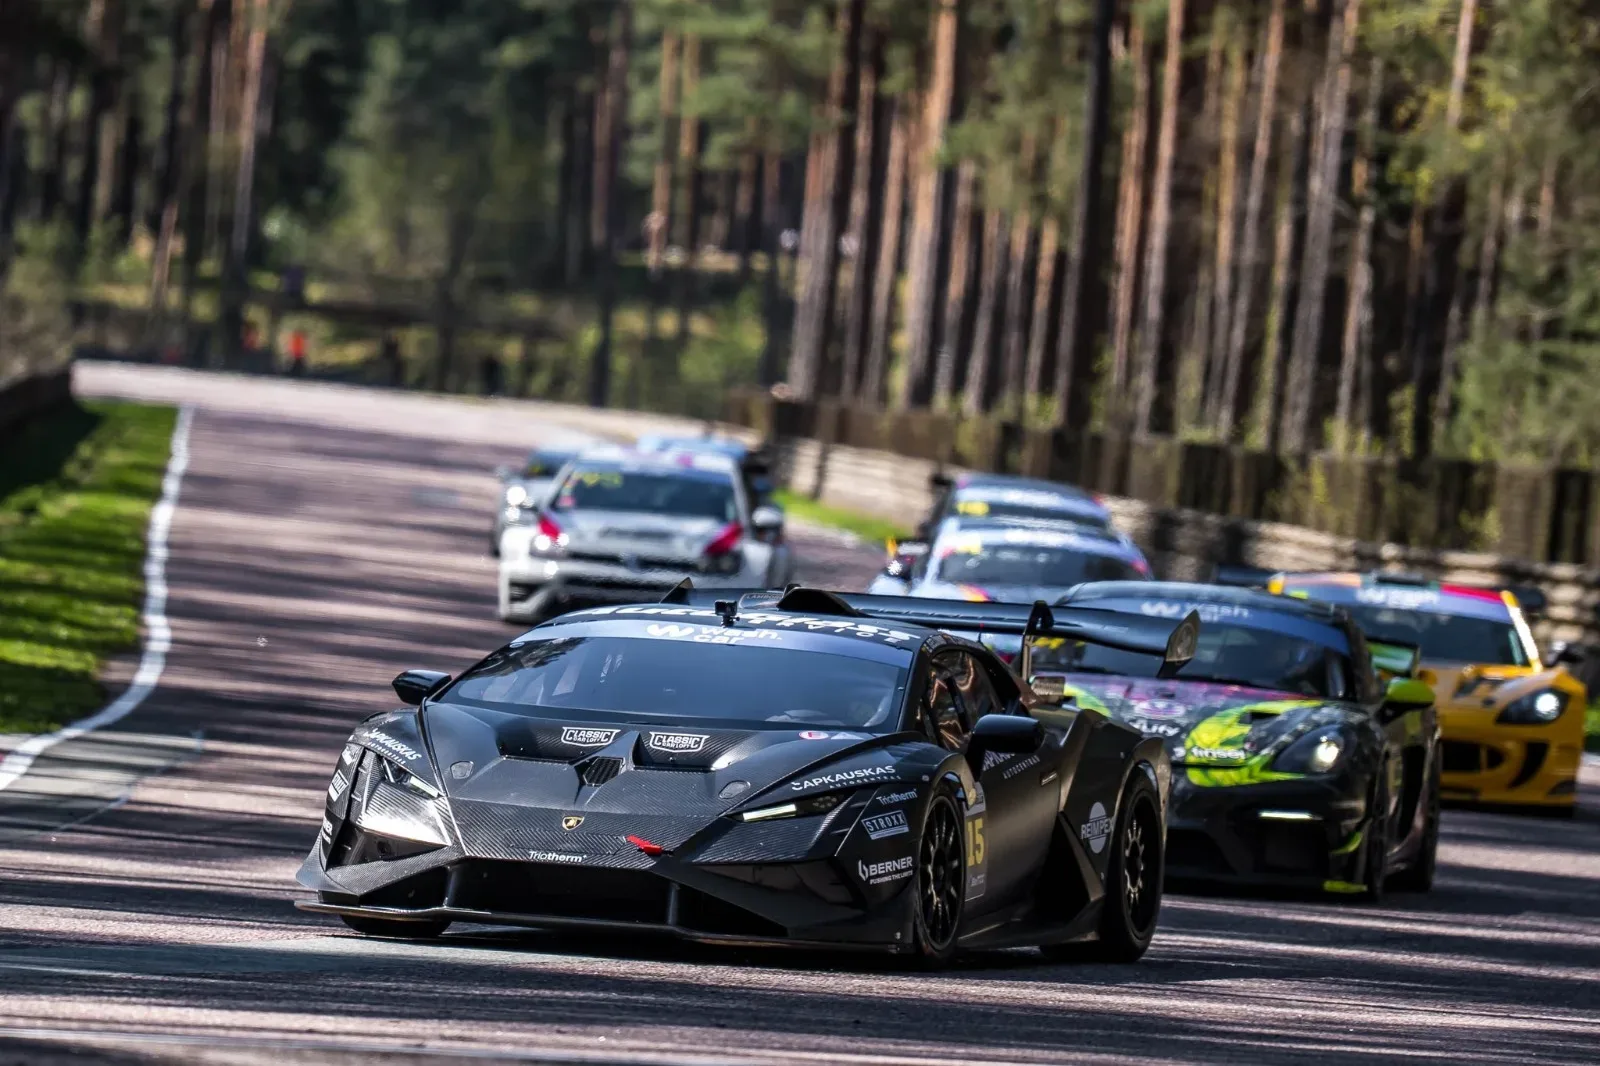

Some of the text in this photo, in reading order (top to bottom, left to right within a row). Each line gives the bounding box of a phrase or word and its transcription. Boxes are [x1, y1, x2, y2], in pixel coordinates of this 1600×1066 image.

[692, 634, 745, 645] car
[565, 729, 611, 743] CLASSIC
[653, 734, 700, 749] CLASSIC
[865, 812, 904, 832] STROXX
[966, 818, 985, 868] 15
[870, 856, 913, 877] BERNER
